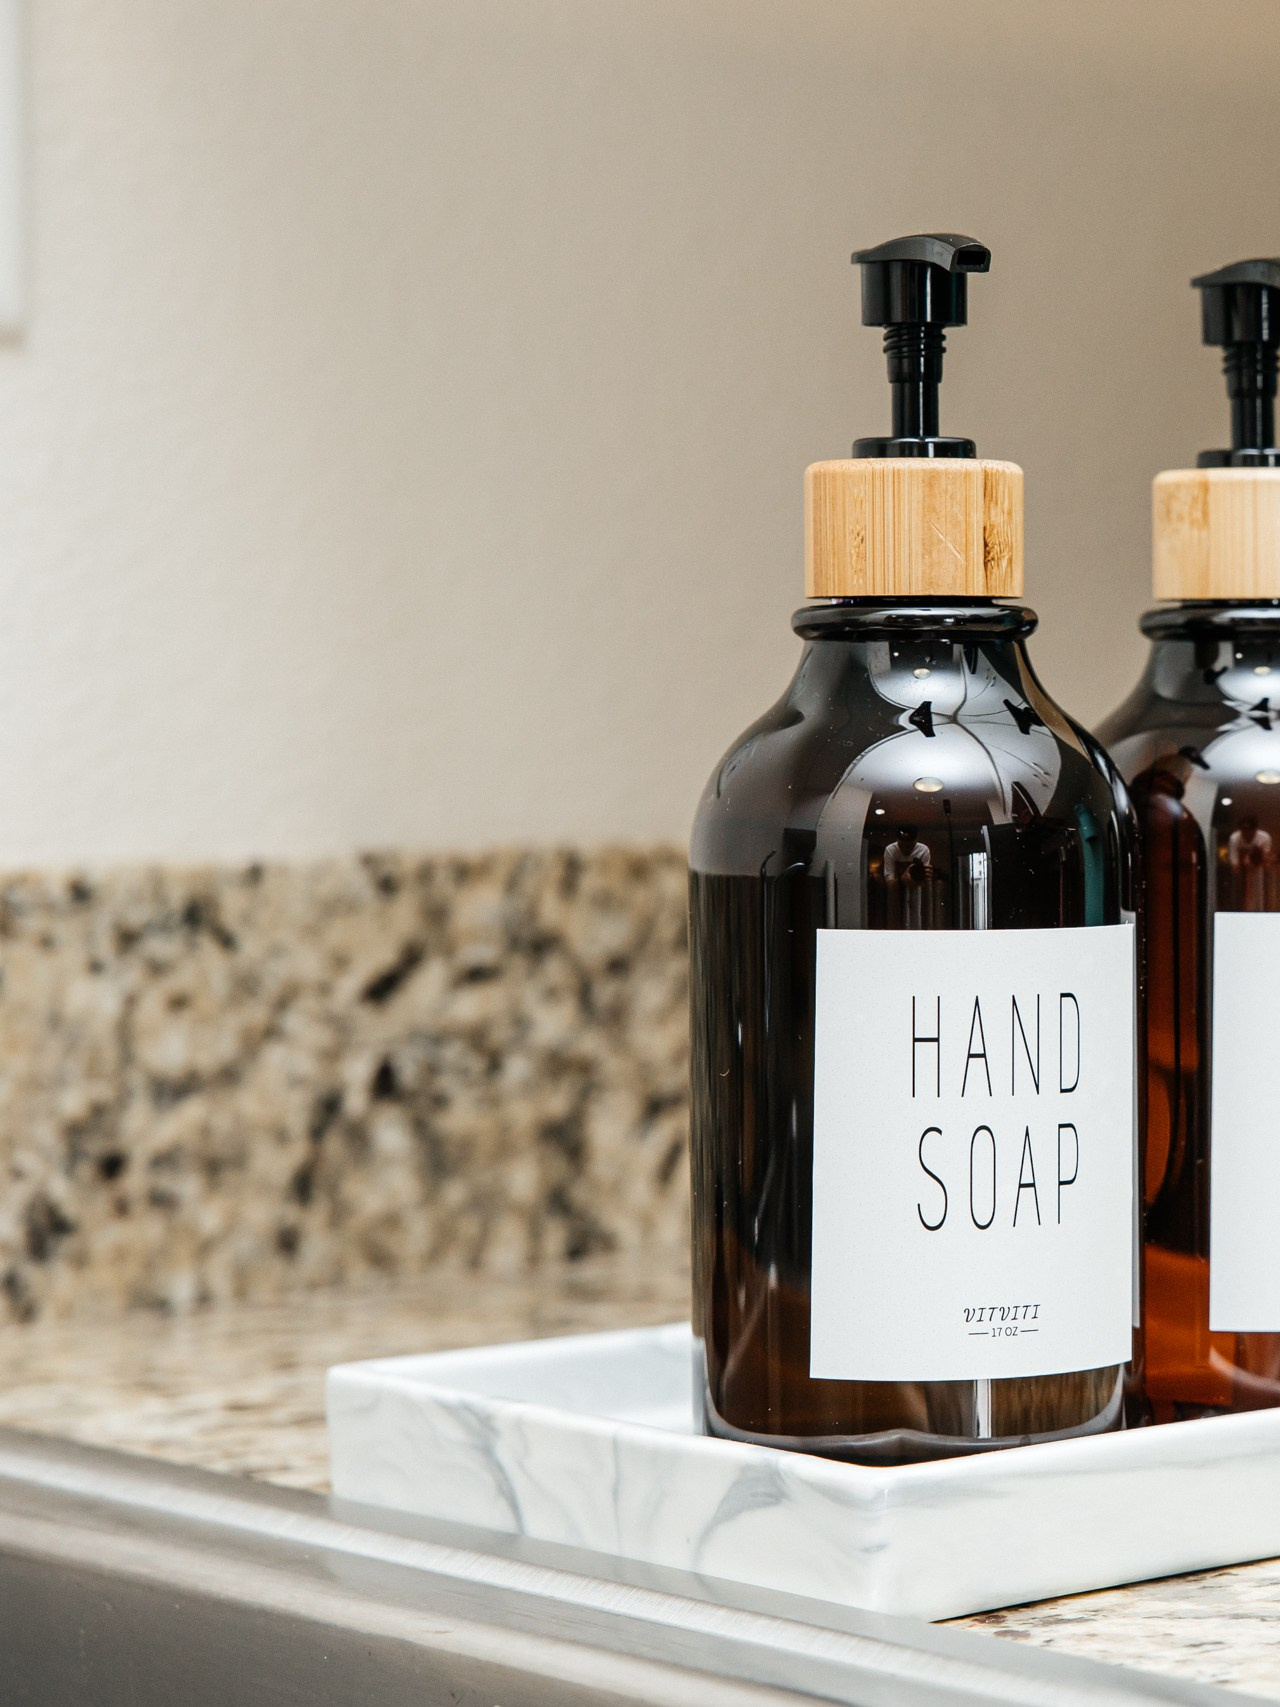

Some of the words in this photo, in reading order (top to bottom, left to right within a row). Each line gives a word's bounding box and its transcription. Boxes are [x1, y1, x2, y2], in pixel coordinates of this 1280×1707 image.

[911, 991, 1081, 1098] HAND
[916, 1122, 1080, 1232] SOAP
[963, 1303, 1041, 1323] VITVITI
[991, 1327, 1003, 1338] 17
[1004, 1326, 1019, 1337] OZ
